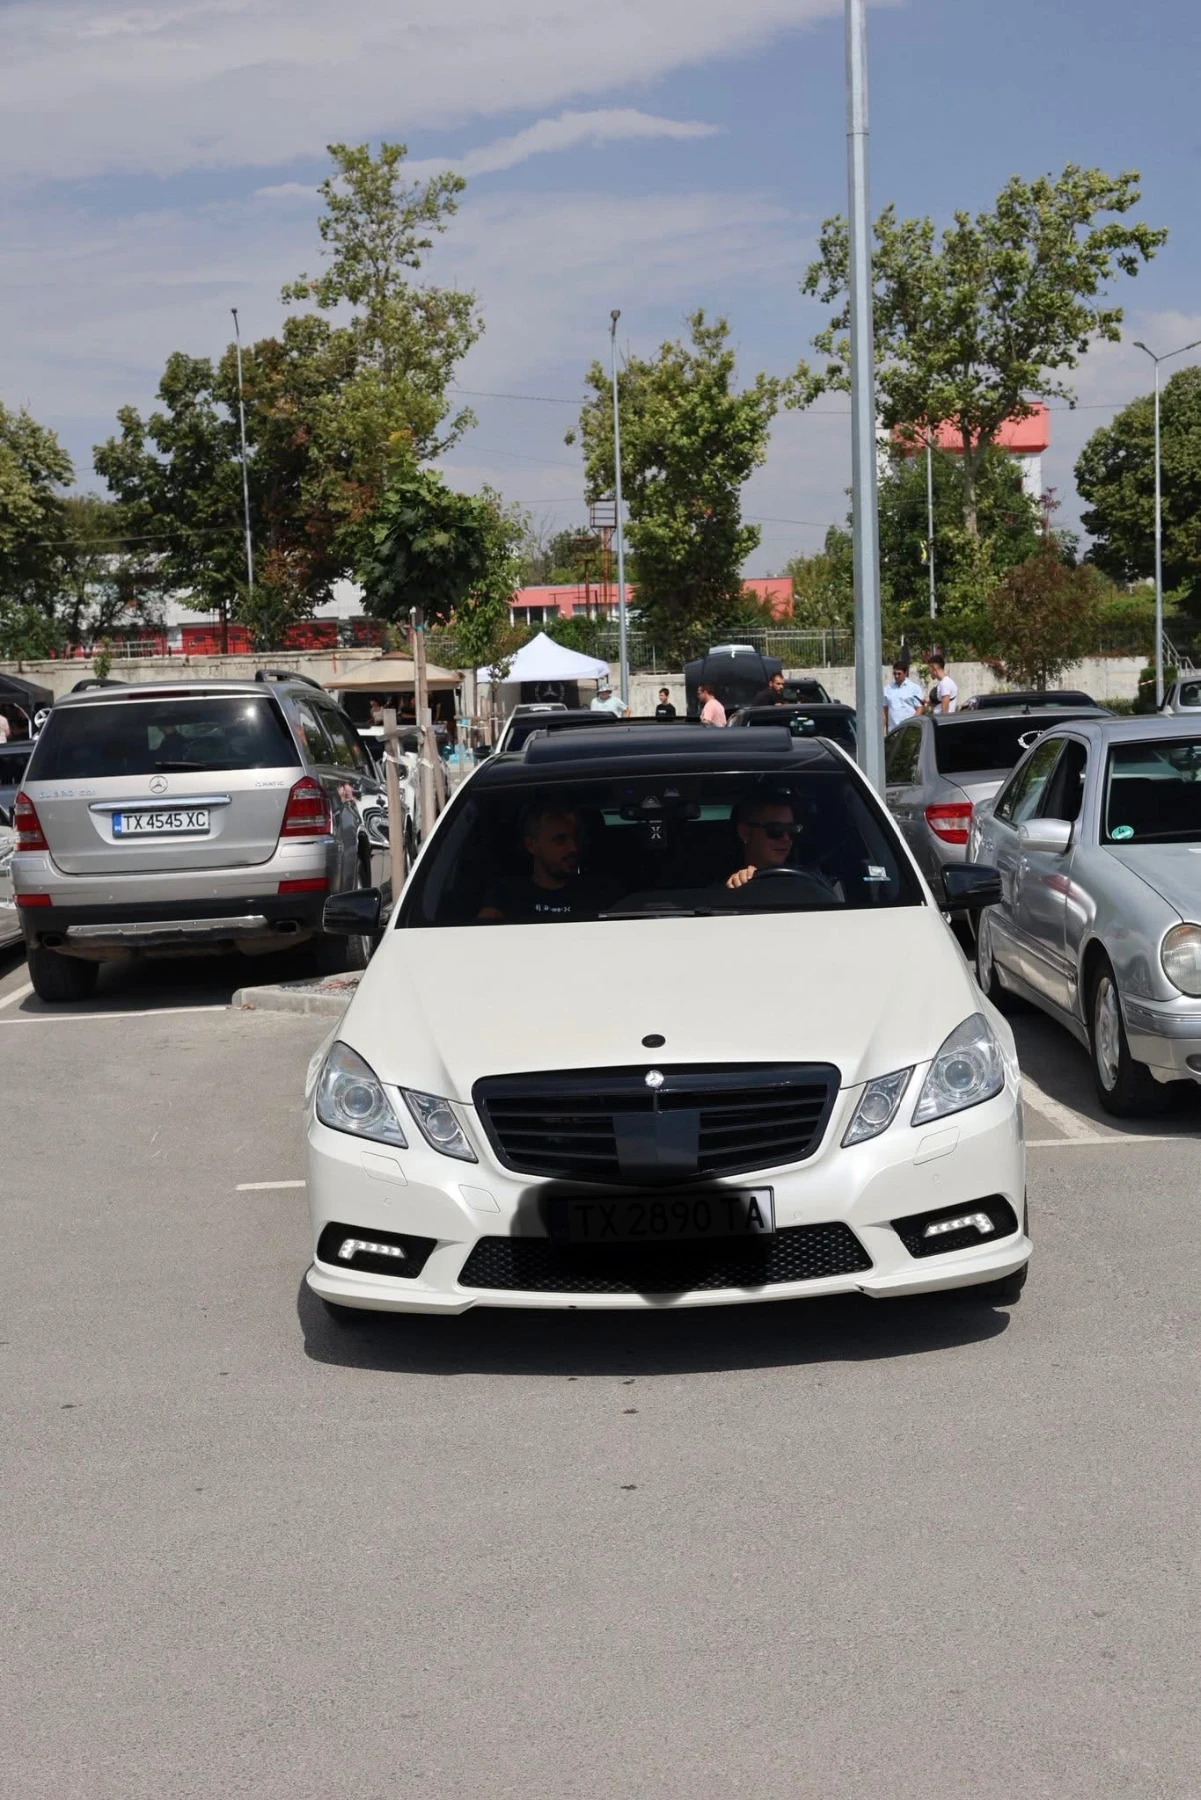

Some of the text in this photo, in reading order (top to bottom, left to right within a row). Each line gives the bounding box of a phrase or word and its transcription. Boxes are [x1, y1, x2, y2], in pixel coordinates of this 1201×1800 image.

[123, 811, 206, 831] TX 4545 XC
[574, 1203, 618, 1238] TX
[627, 1199, 712, 1236] 2890
[719, 1196, 765, 1232] TA
